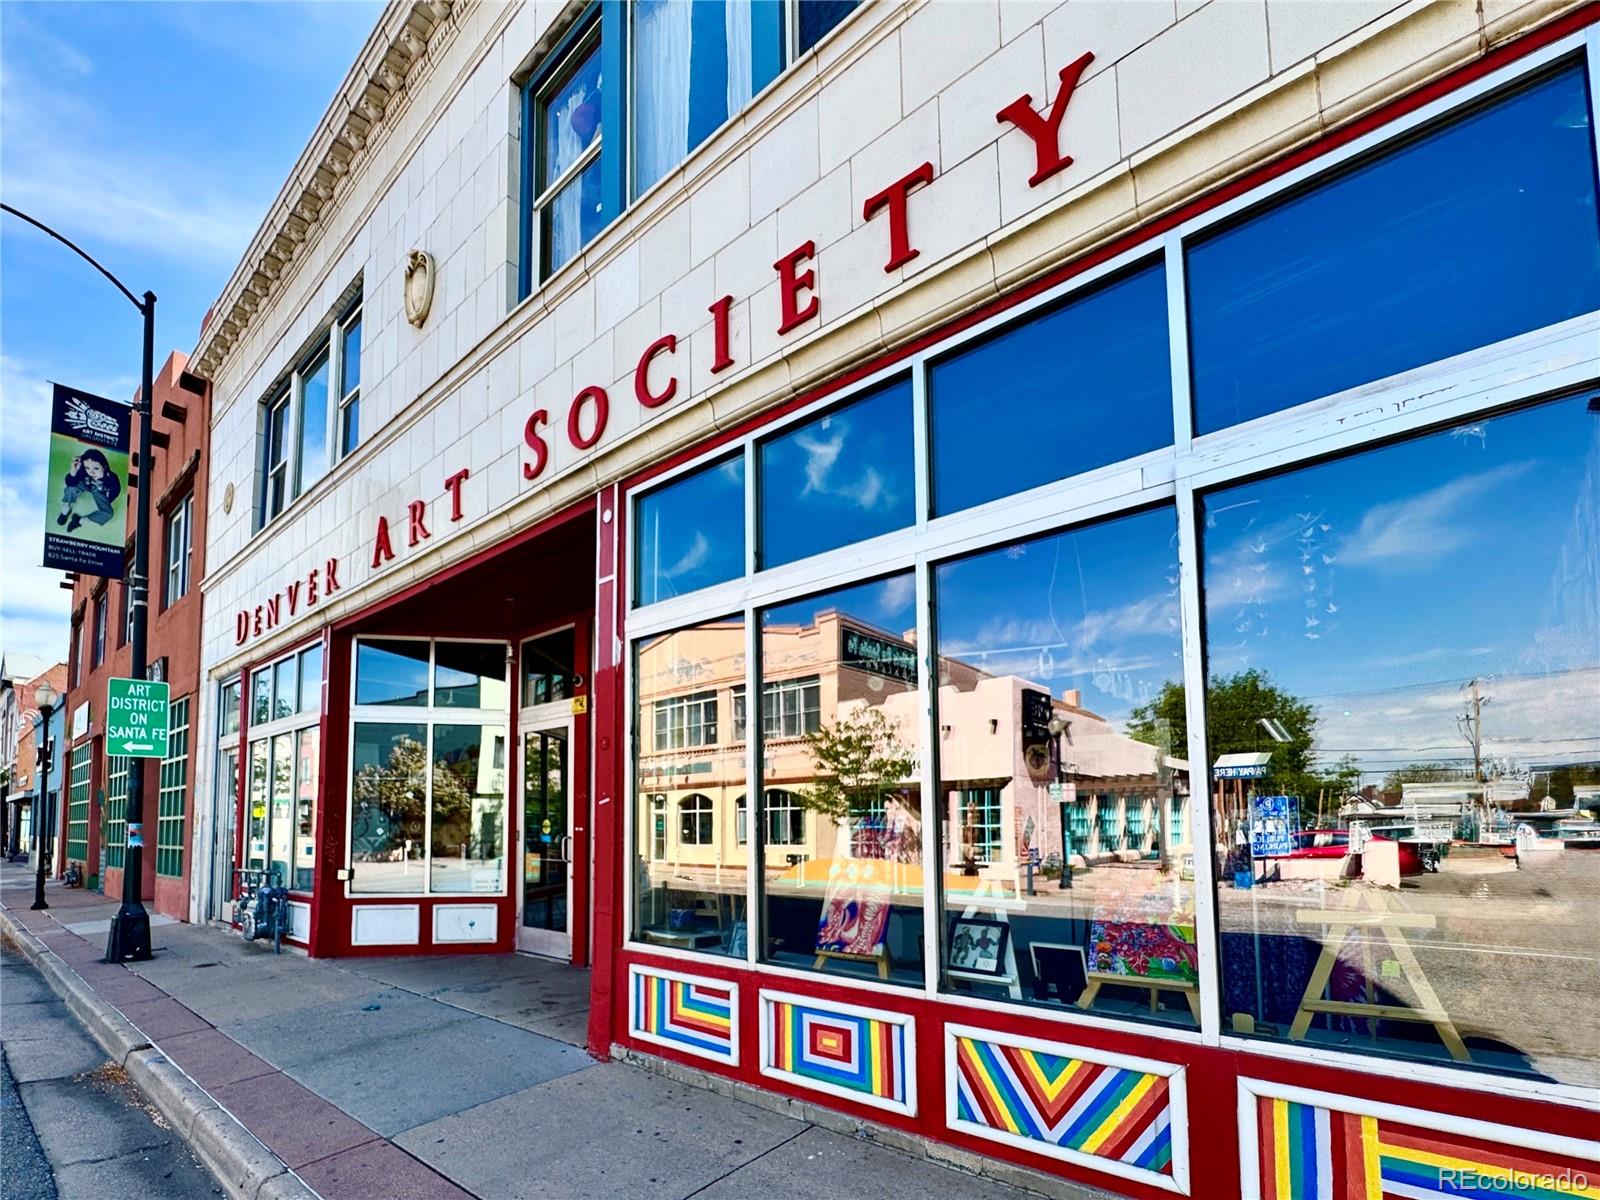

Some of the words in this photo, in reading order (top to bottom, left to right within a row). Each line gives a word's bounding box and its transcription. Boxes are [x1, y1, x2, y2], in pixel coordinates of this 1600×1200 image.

[236, 558, 340, 646] DENVER
[371, 468, 469, 568] ART
[523, 51, 1095, 480] SOCIETY
[48, 536, 88, 549] STRAWBERRY
[88, 543, 121, 554] MOUNTAIN
[127, 683, 151, 697] ART
[111, 696, 166, 712] DISTRICT
[130, 712, 148, 725] ON
[109, 725, 147, 740] SANTA
[151, 728, 167, 741] FE
